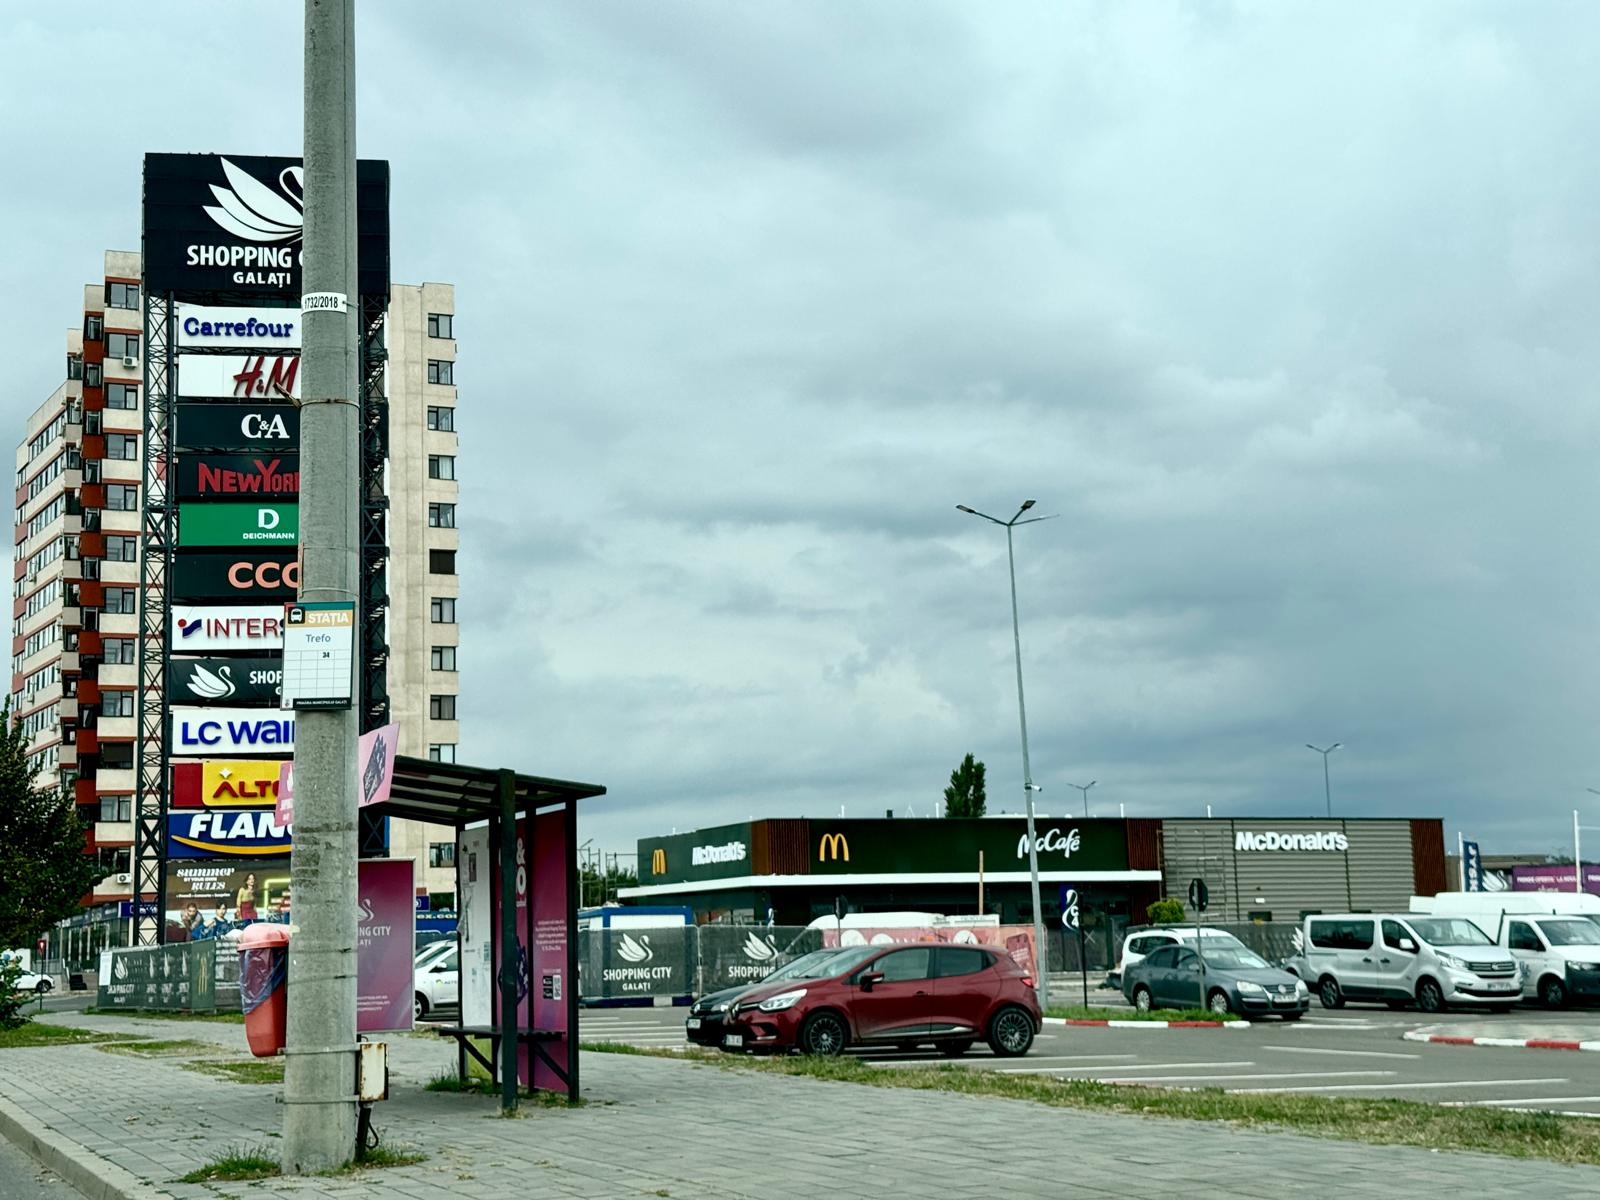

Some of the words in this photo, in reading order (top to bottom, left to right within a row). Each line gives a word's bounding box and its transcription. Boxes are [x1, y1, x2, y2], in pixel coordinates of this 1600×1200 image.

[187, 245, 292, 268] SHOPPING
[233, 272, 291, 288] GALAȚI
[184, 317, 294, 337] Carrefour
[233, 355, 300, 396] H&M
[241, 414, 290, 439] C&A
[258, 509, 280, 529] D
[242, 532, 295, 540] DEICHMANN
[306, 634, 331, 643] Trefo
[182, 721, 222, 745] LC
[1235, 831, 1349, 850] McDonald's
[692, 841, 746, 865] McDonald's
[372, 926, 391, 936] CITY
[603, 968, 650, 980] SHOPPING
[652, 967, 671, 979] CITY
